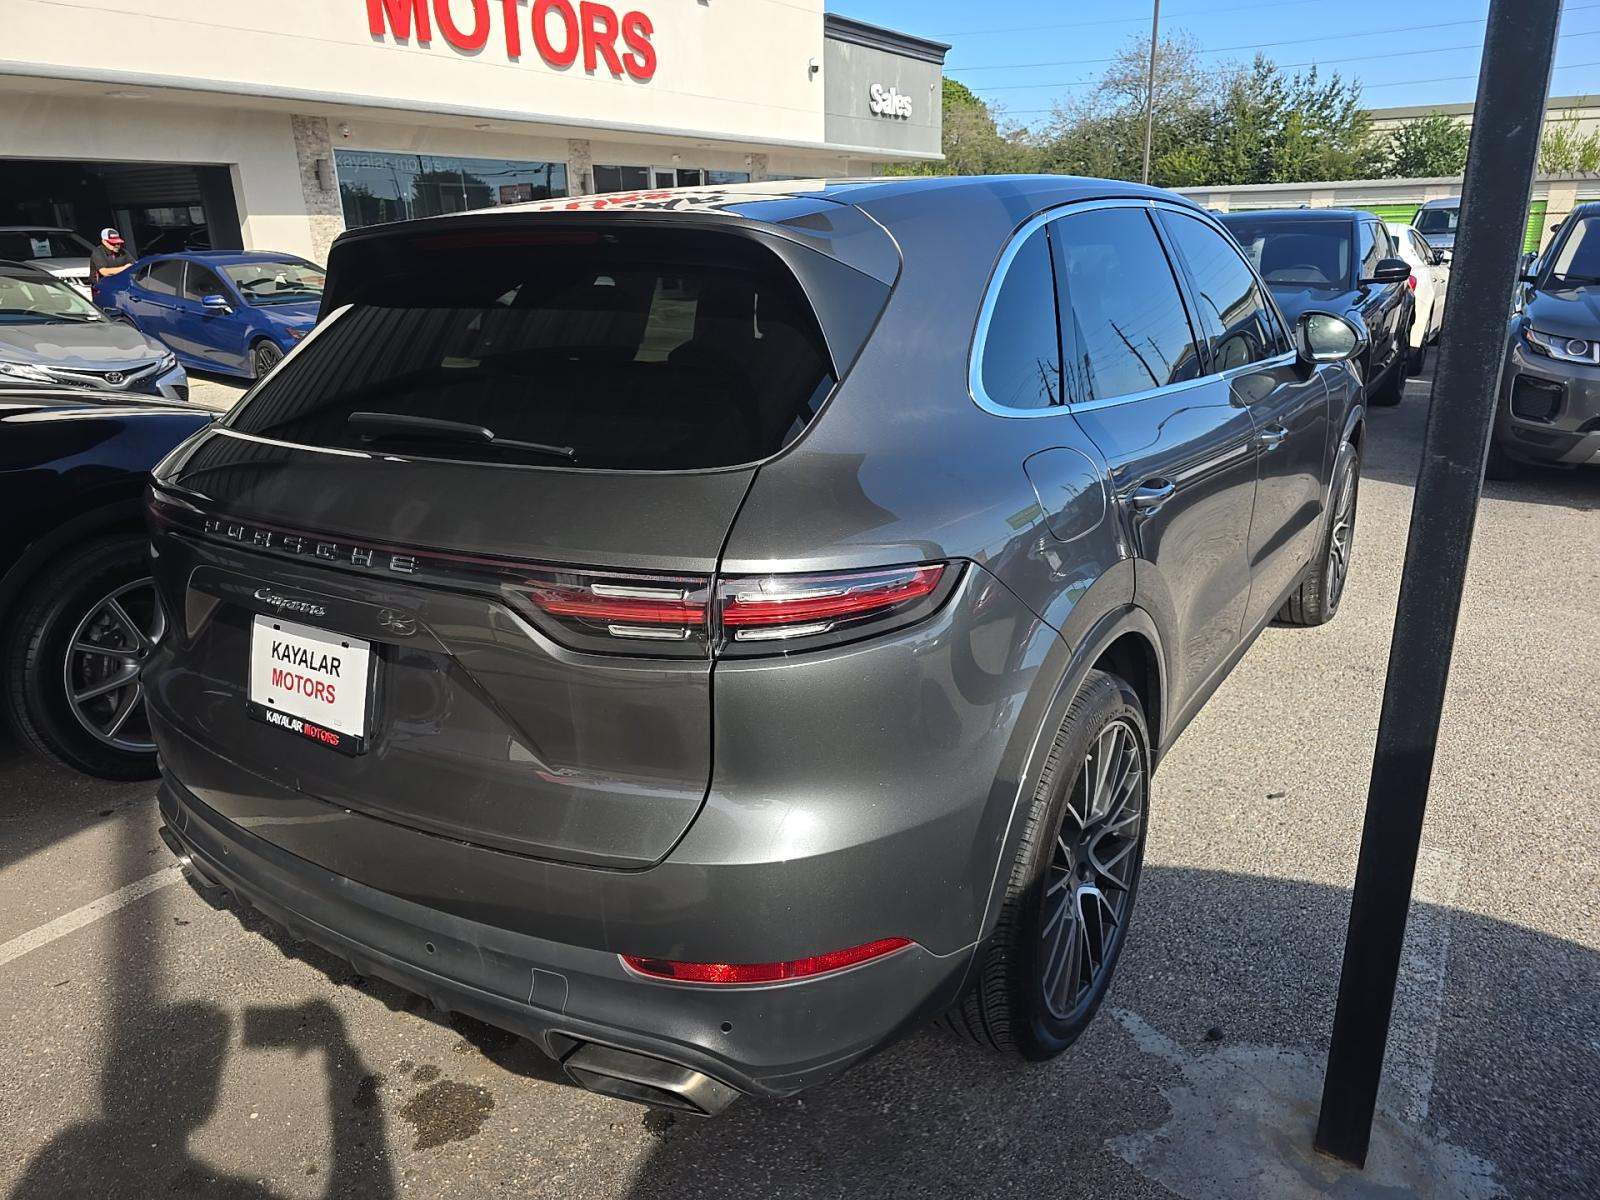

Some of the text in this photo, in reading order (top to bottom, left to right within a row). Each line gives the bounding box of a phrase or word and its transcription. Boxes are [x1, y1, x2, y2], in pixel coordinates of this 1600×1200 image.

[869, 83, 913, 118] Sales
[271, 640, 341, 678] KAYALAR
[271, 667, 336, 705] MOTORS
[266, 710, 340, 746] KAYALAR MOTORS
